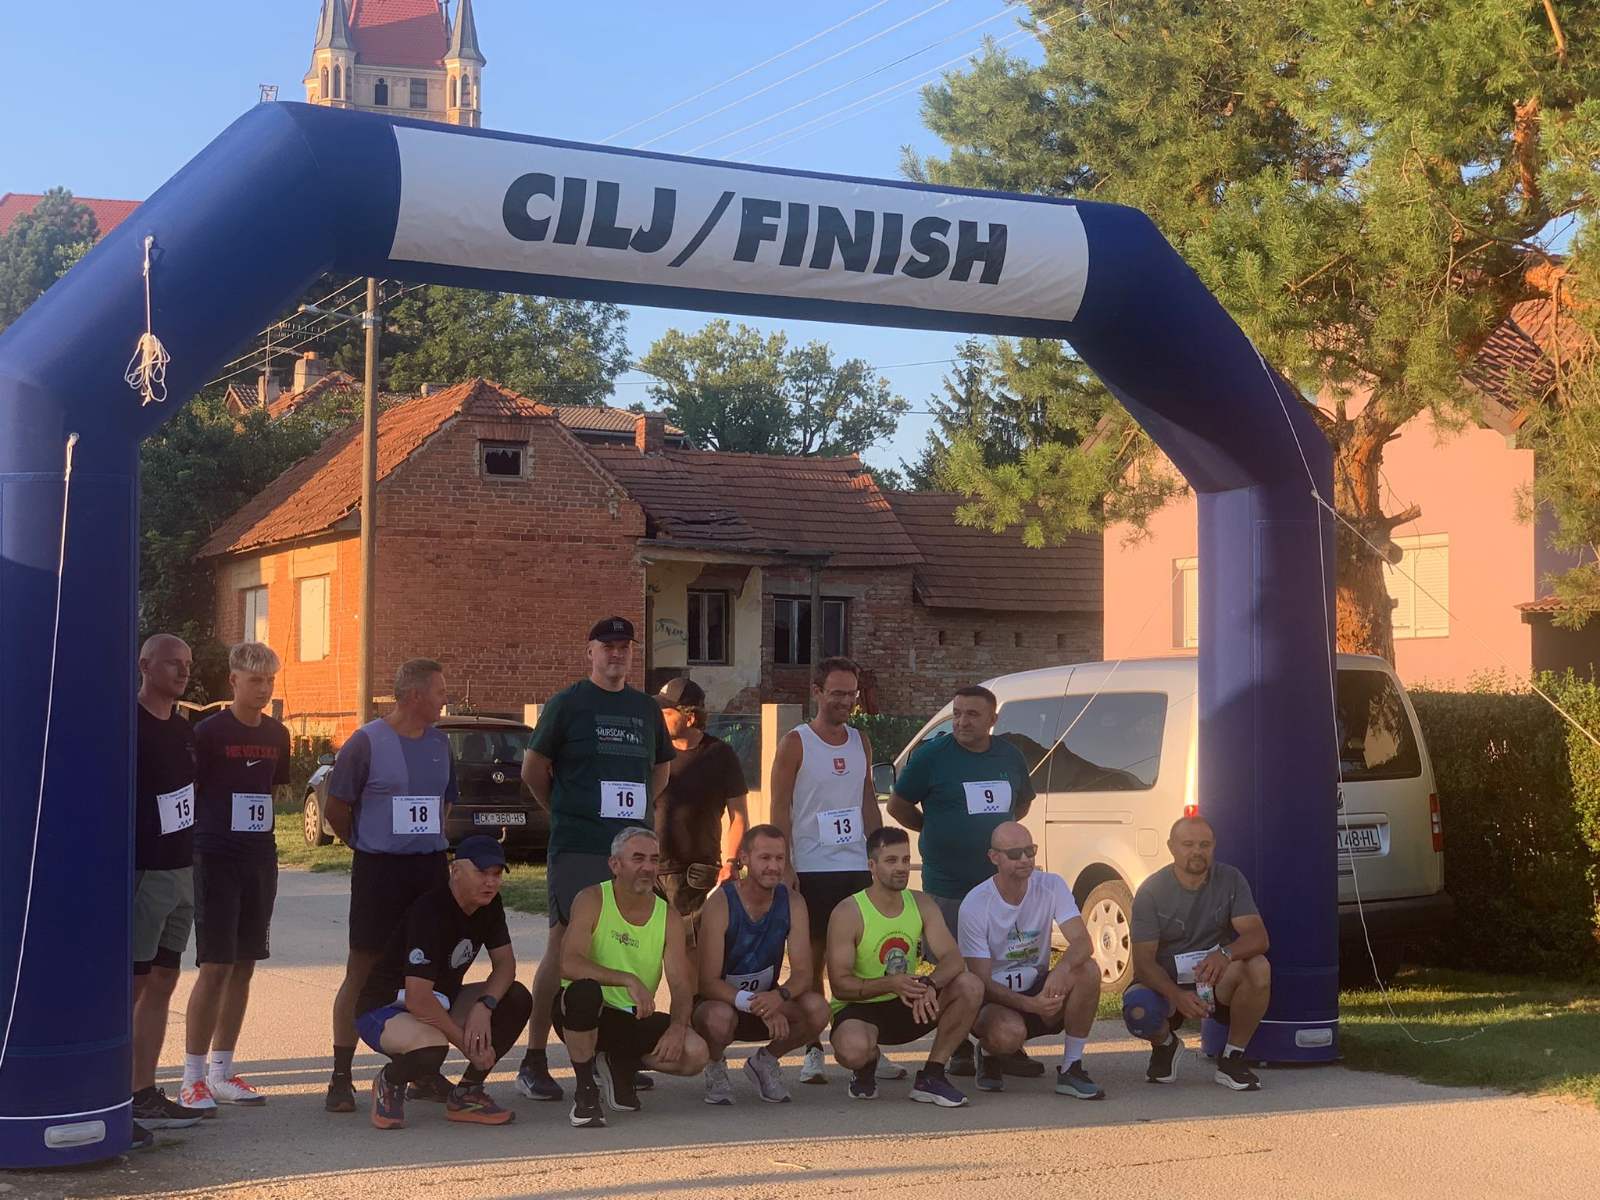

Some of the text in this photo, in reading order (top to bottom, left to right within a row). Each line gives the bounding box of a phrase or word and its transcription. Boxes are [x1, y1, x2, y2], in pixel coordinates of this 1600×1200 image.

[616, 791, 634, 807] 16
[984, 789, 994, 804] 9
[175, 799, 190, 819] 15
[248, 804, 265, 821] 19
[409, 806, 428, 823] 18
[834, 818, 852, 835] 13
[740, 979, 759, 991] 20
[1005, 973, 1022, 989] 11
